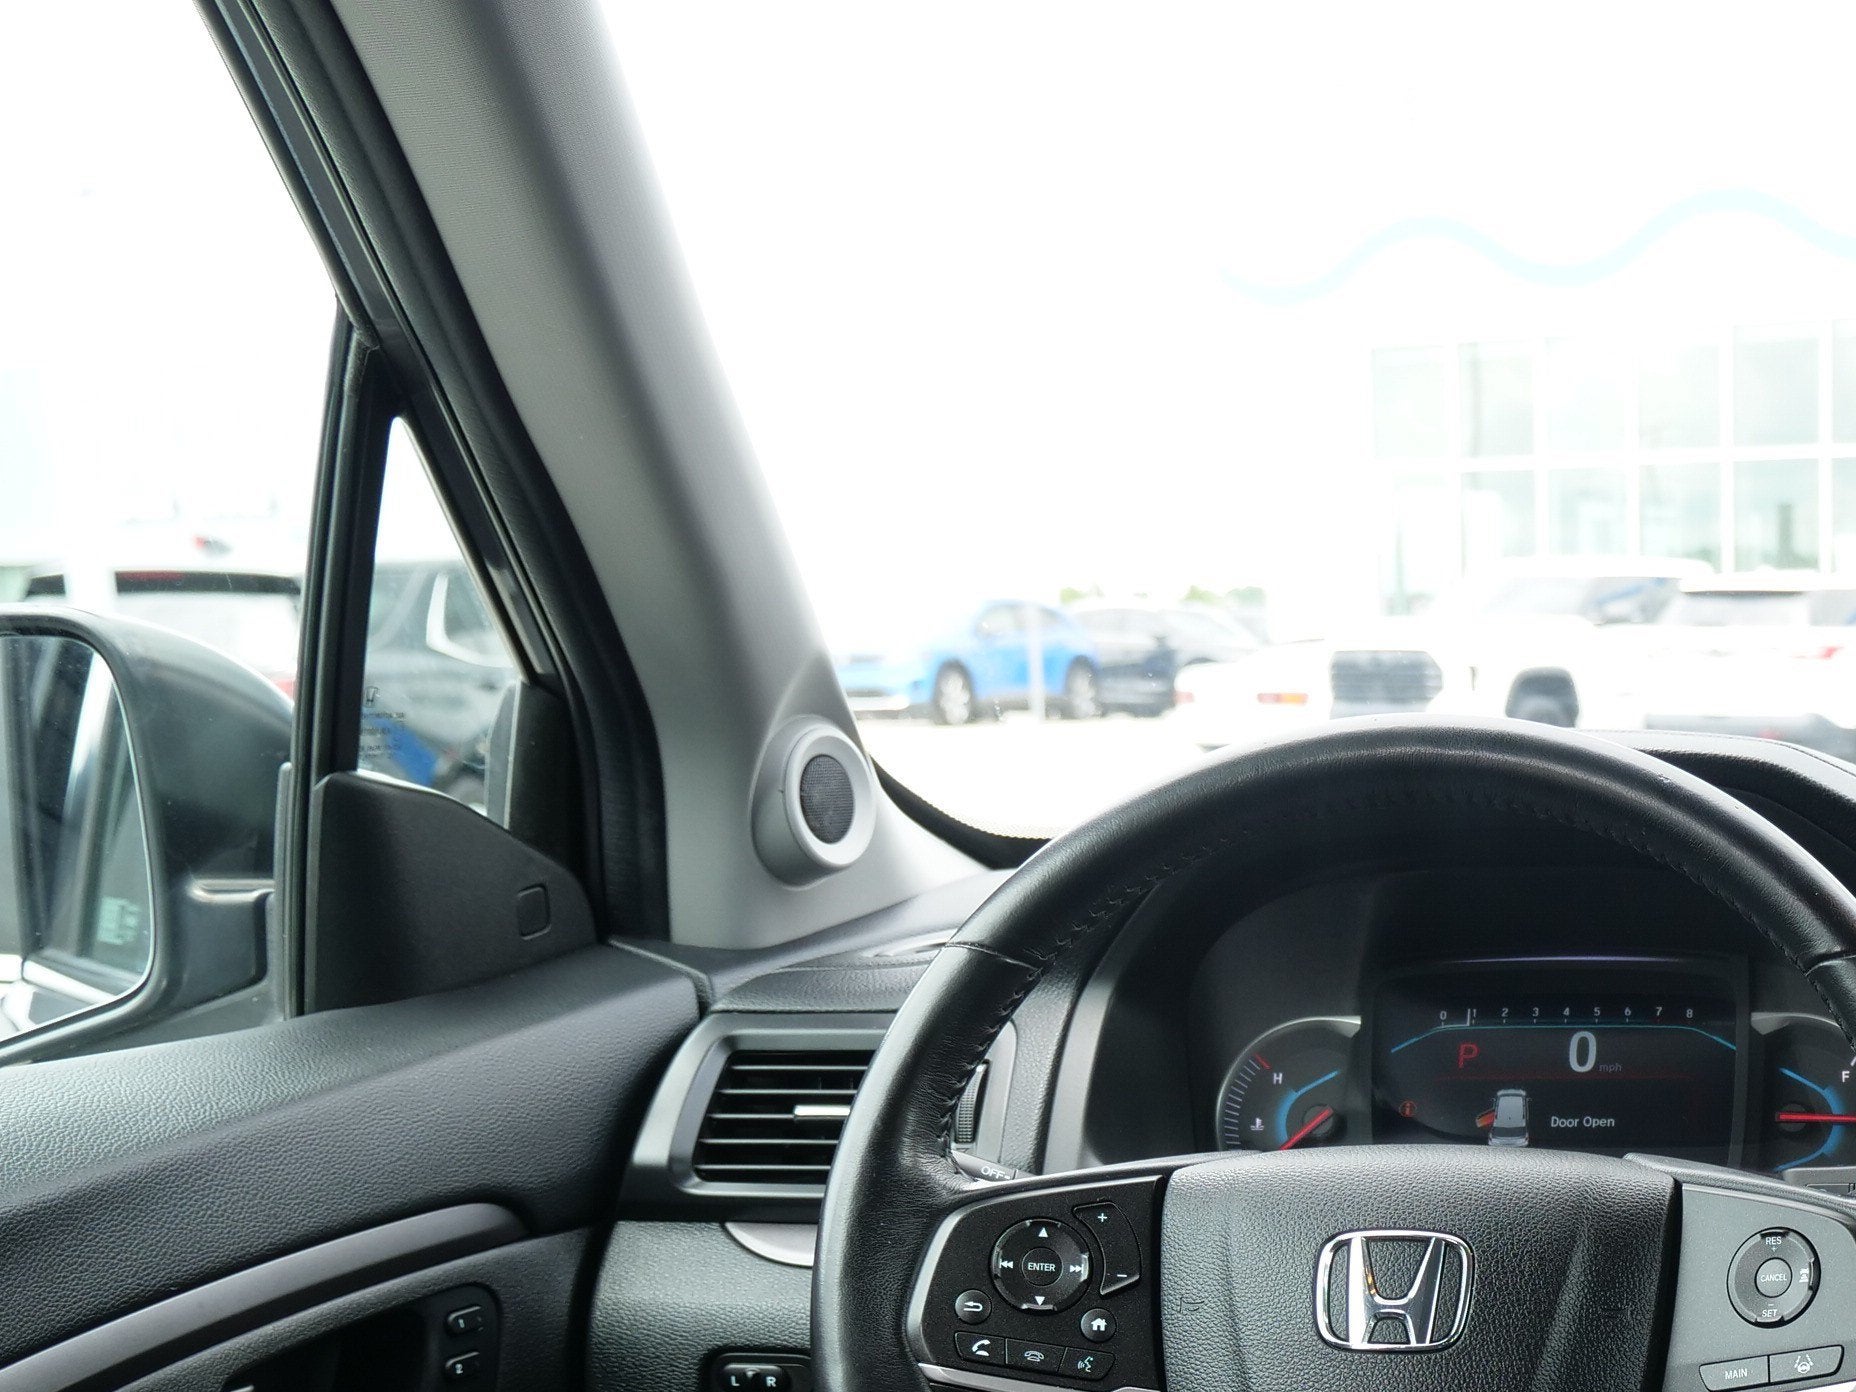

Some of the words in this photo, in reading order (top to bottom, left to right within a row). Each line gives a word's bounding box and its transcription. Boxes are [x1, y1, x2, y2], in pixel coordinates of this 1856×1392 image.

[1439, 1010, 1447, 1021] 0
[1471, 1008, 1477, 1017] 1
[1501, 1007, 1509, 1017] 2
[1532, 1007, 1540, 1017] 3
[1563, 1007, 1570, 1017] 4
[1594, 1007, 1601, 1017] 5
[1624, 1007, 1632, 1017] 6
[1656, 1007, 1663, 1017] 7
[1686, 1008, 1694, 1019] 8
[1457, 1042, 1479, 1069] P
[1568, 1031, 1597, 1073] 0
[1599, 1062, 1622, 1073] mph
[1273, 1072, 1282, 1085] H
[1841, 1070, 1850, 1083] F
[1550, 1116, 1580, 1128] Door
[1583, 1116, 1615, 1129] Open
[1765, 1236, 1782, 1245] RES
[1028, 1262, 1056, 1272] ENTER
[1760, 1273, 1788, 1283] CANCEL
[1762, 1309, 1778, 1318] SET
[1724, 1368, 1748, 1380] MAIN
[731, 1376, 740, 1388] L
[766, 1376, 777, 1389] R
